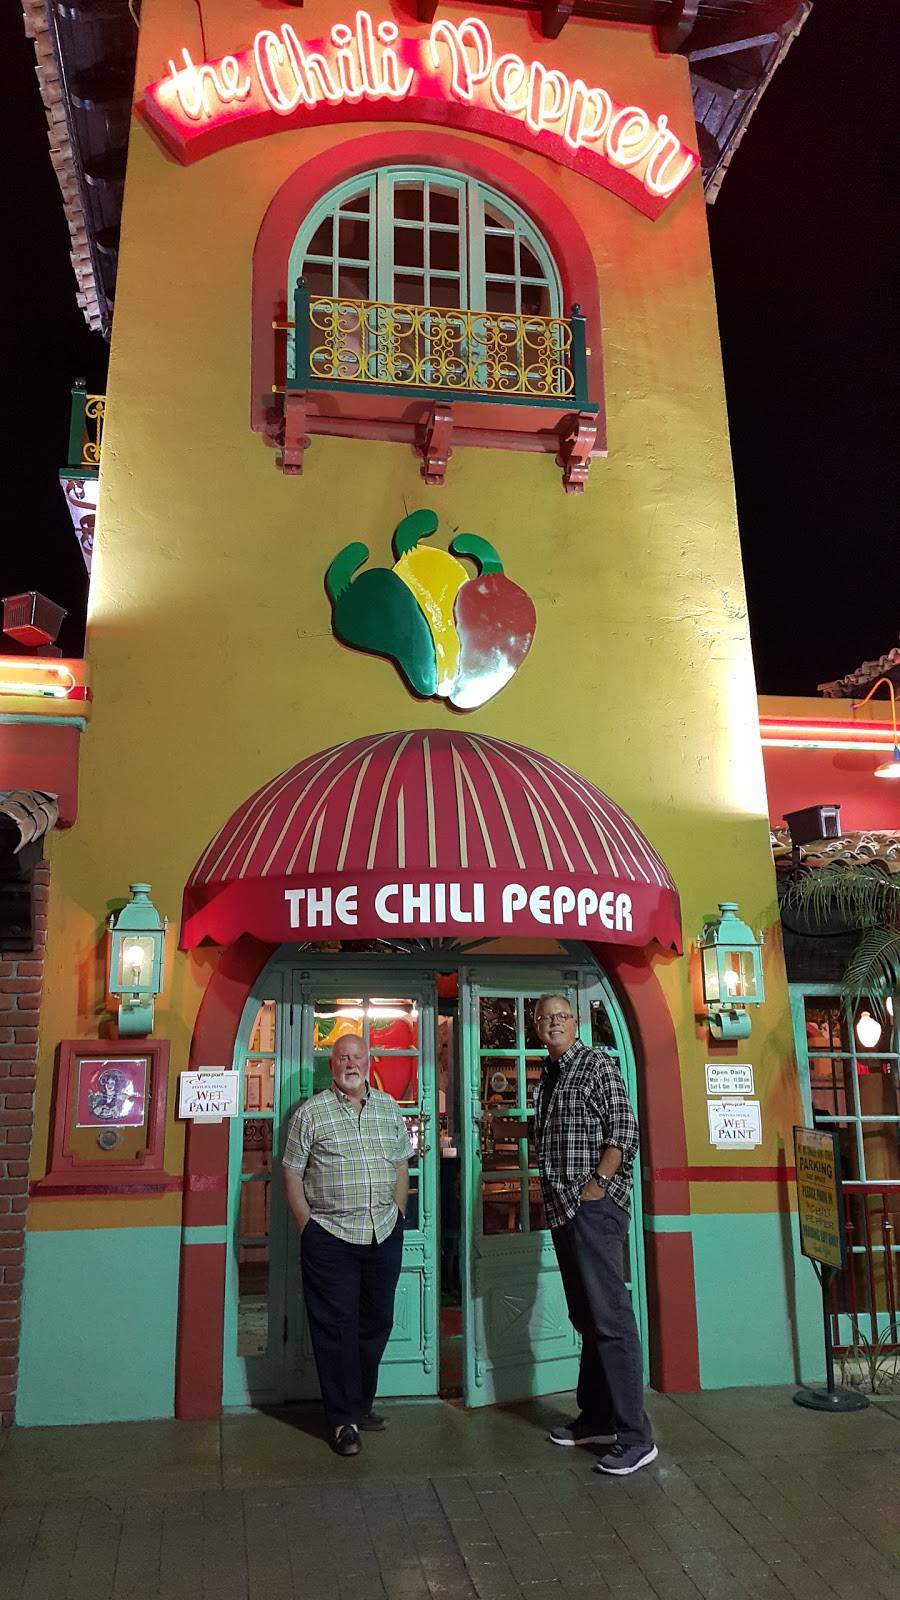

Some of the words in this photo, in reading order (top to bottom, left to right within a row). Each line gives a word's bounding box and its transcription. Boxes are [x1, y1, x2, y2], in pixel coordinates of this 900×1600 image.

[160, 47, 251, 120] the
[254, 9, 414, 112] Chili
[429, 16, 693, 197] Pepper
[284, 886, 358, 929] THE
[374, 883, 485, 924] CHILI
[502, 884, 634, 933] PEPPER
[196, 1090, 224, 1101] WET
[189, 1102, 230, 1112] PAINT
[723, 1118, 748, 1129] WET
[718, 1129, 754, 1139] PAINT
[800, 1156, 833, 1179] PARKING
